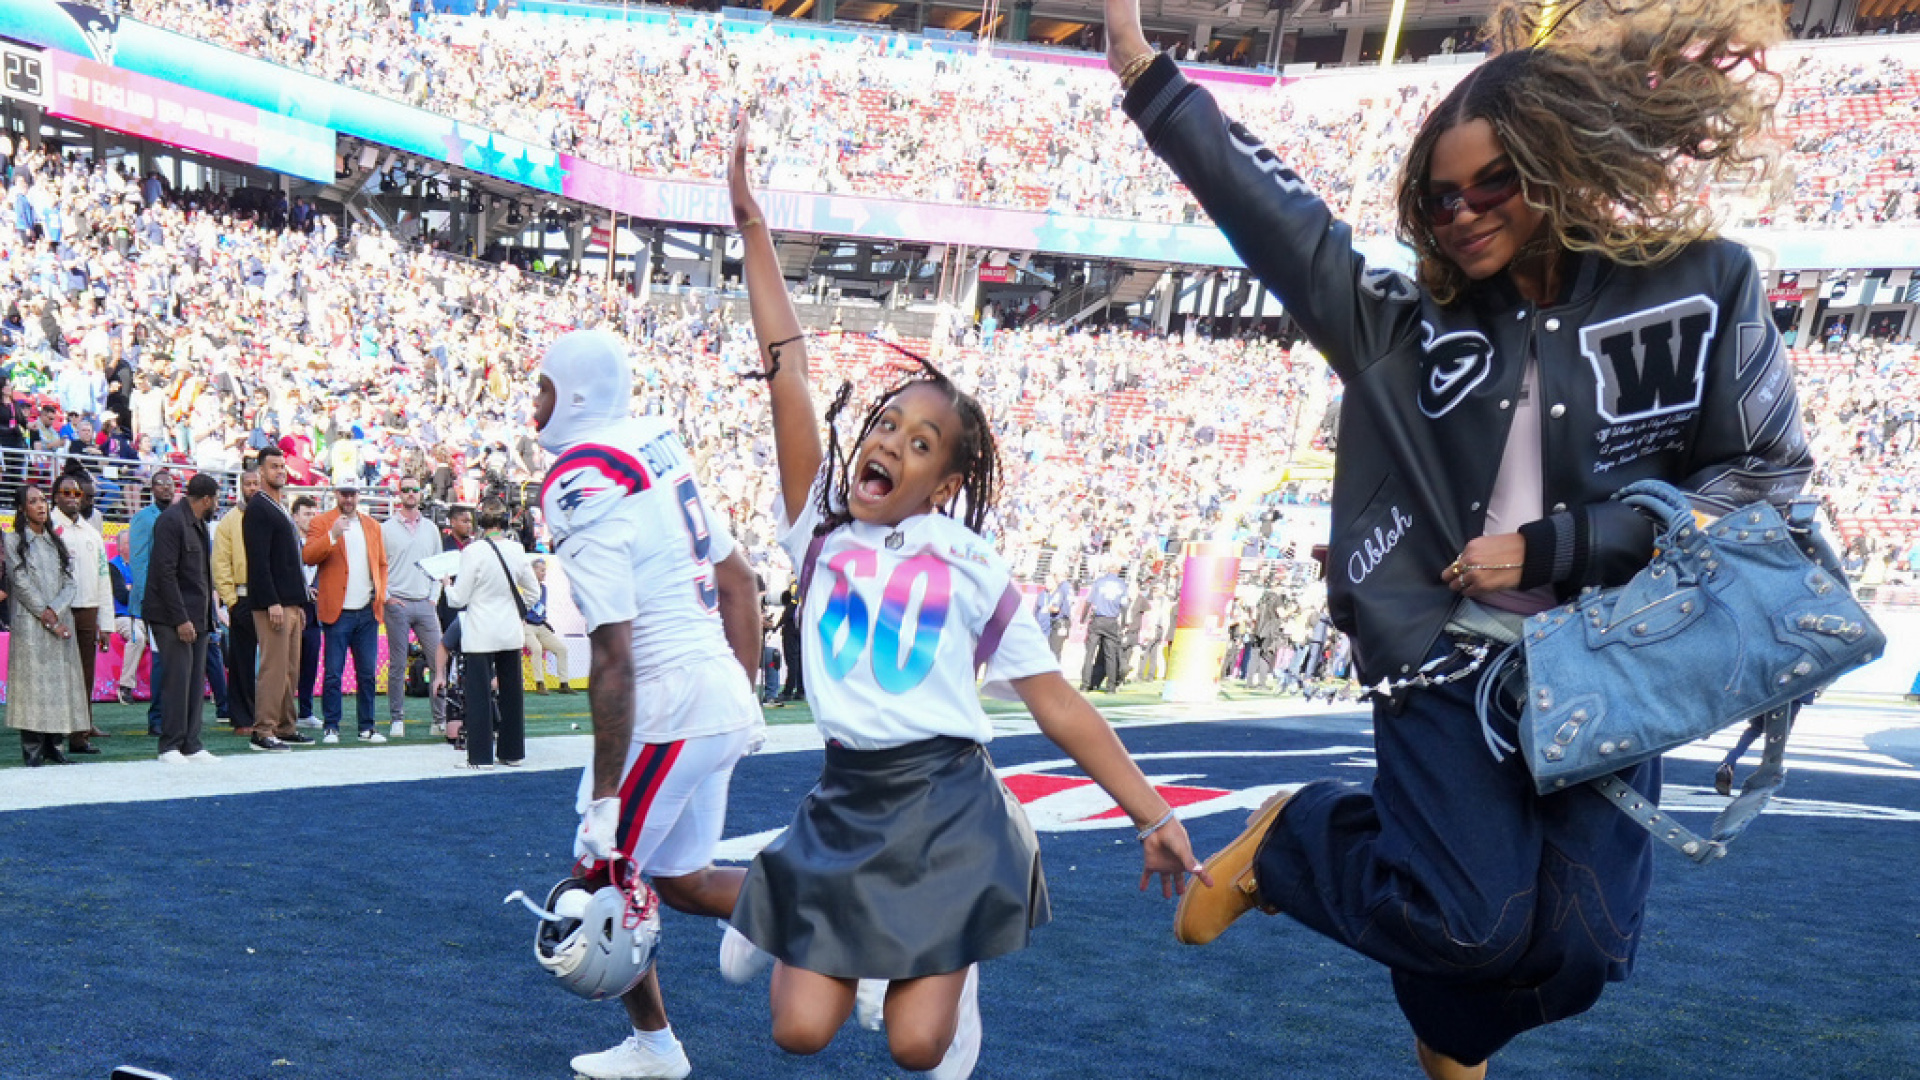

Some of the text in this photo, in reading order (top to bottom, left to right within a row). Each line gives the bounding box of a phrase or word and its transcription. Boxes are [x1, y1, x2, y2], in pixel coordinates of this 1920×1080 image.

[4, 51, 42, 96] 25
[57, 70, 89, 101] NEW
[93, 80, 154, 119] ENGLAND
[657, 182, 730, 221] SUPER
[812, 198, 905, 237] LX
[1590, 303, 1716, 419] W
[673, 473, 720, 616] 9
[1347, 505, 1413, 584] Abloh
[818, 549, 950, 694] 60
